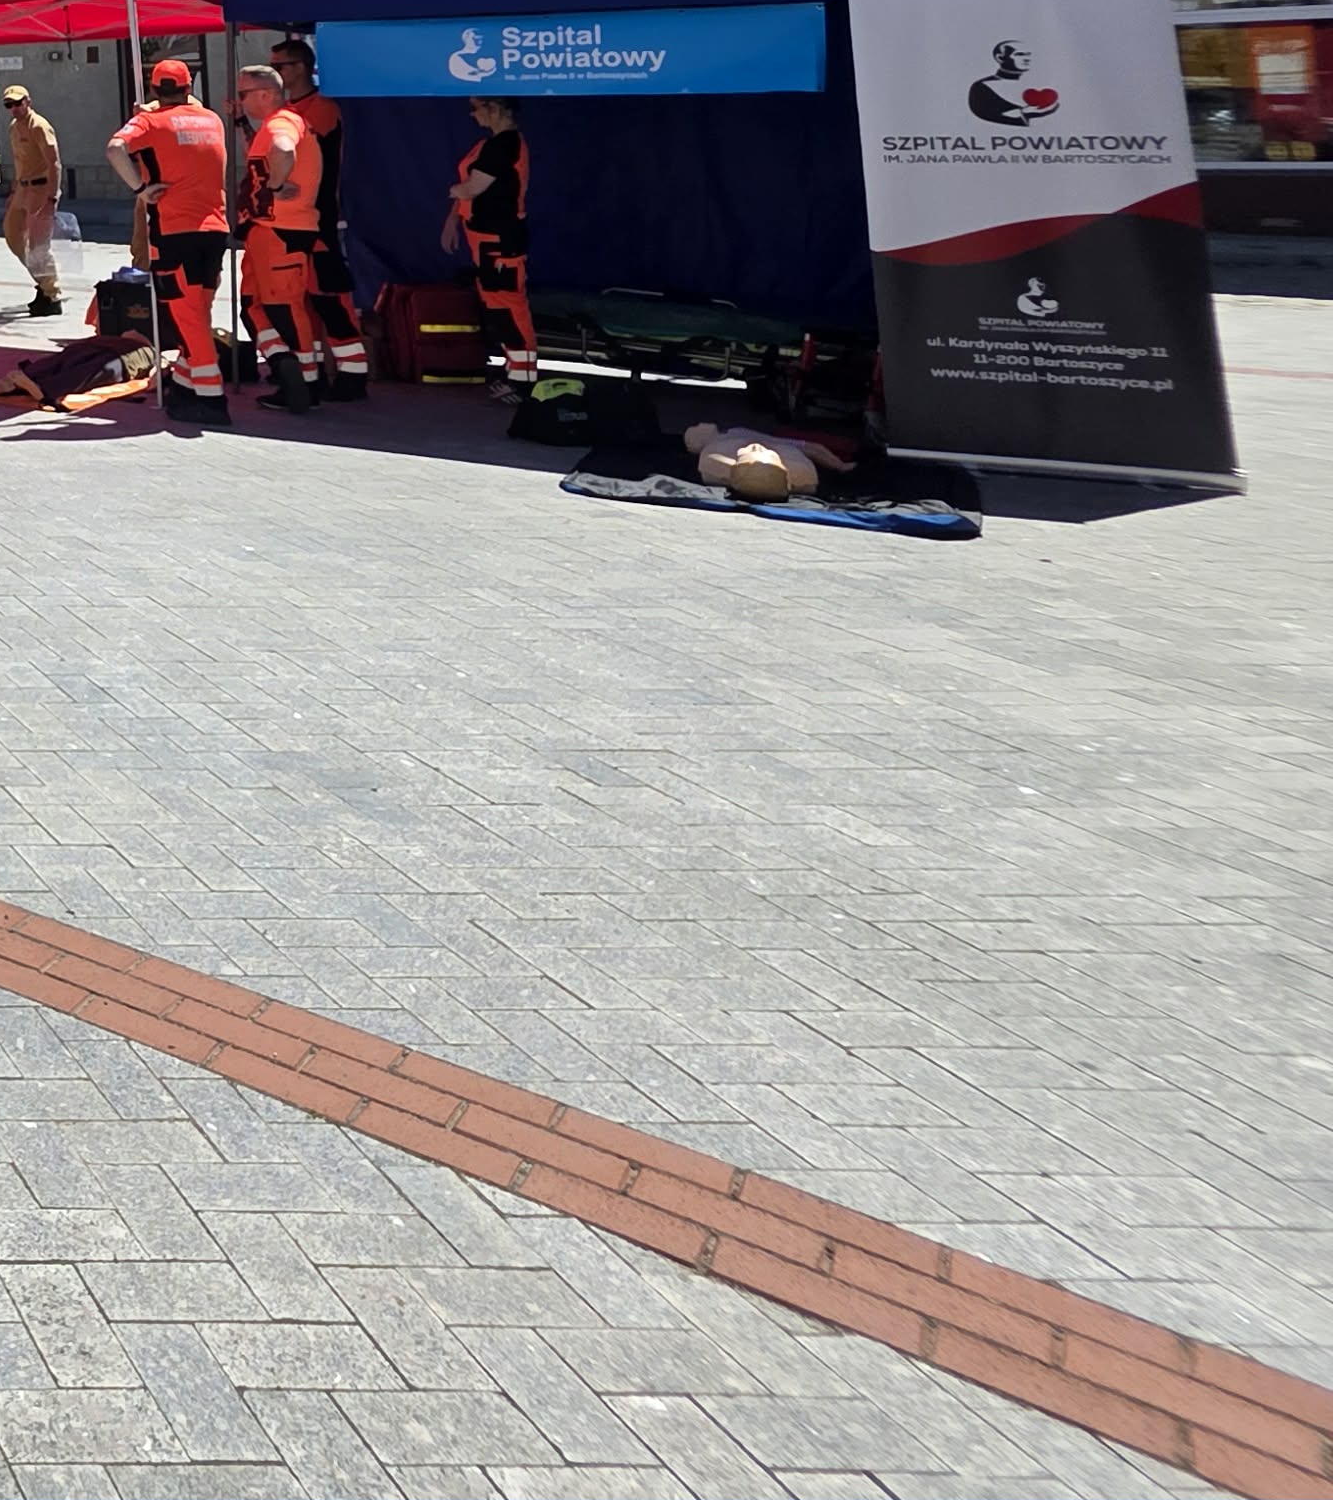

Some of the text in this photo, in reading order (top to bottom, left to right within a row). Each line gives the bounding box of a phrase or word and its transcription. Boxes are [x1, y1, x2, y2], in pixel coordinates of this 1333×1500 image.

[502, 24, 601, 51] Szpital
[502, 47, 666, 72] Powiatowy
[882, 136, 1168, 151] SZPITAL POWIATOWY
[883, 154, 904, 164] IM.
[907, 154, 950, 164] JANA
[952, 154, 1009, 164] PAWŁA
[1022, 155, 1039, 163] W
[1042, 154, 1171, 165] BARTOSZYCACH
[978, 317, 1105, 329] SZPITAL POWIATOWY
[926, 337, 945, 347] ul.
[949, 338, 1030, 352] Kardynała
[1032, 342, 1148, 359] Wyszyńskiego
[973, 354, 1125, 372] 11-200 Bartoszyce
[930, 367, 1174, 392] www.szpital-bartoszyce.pl
